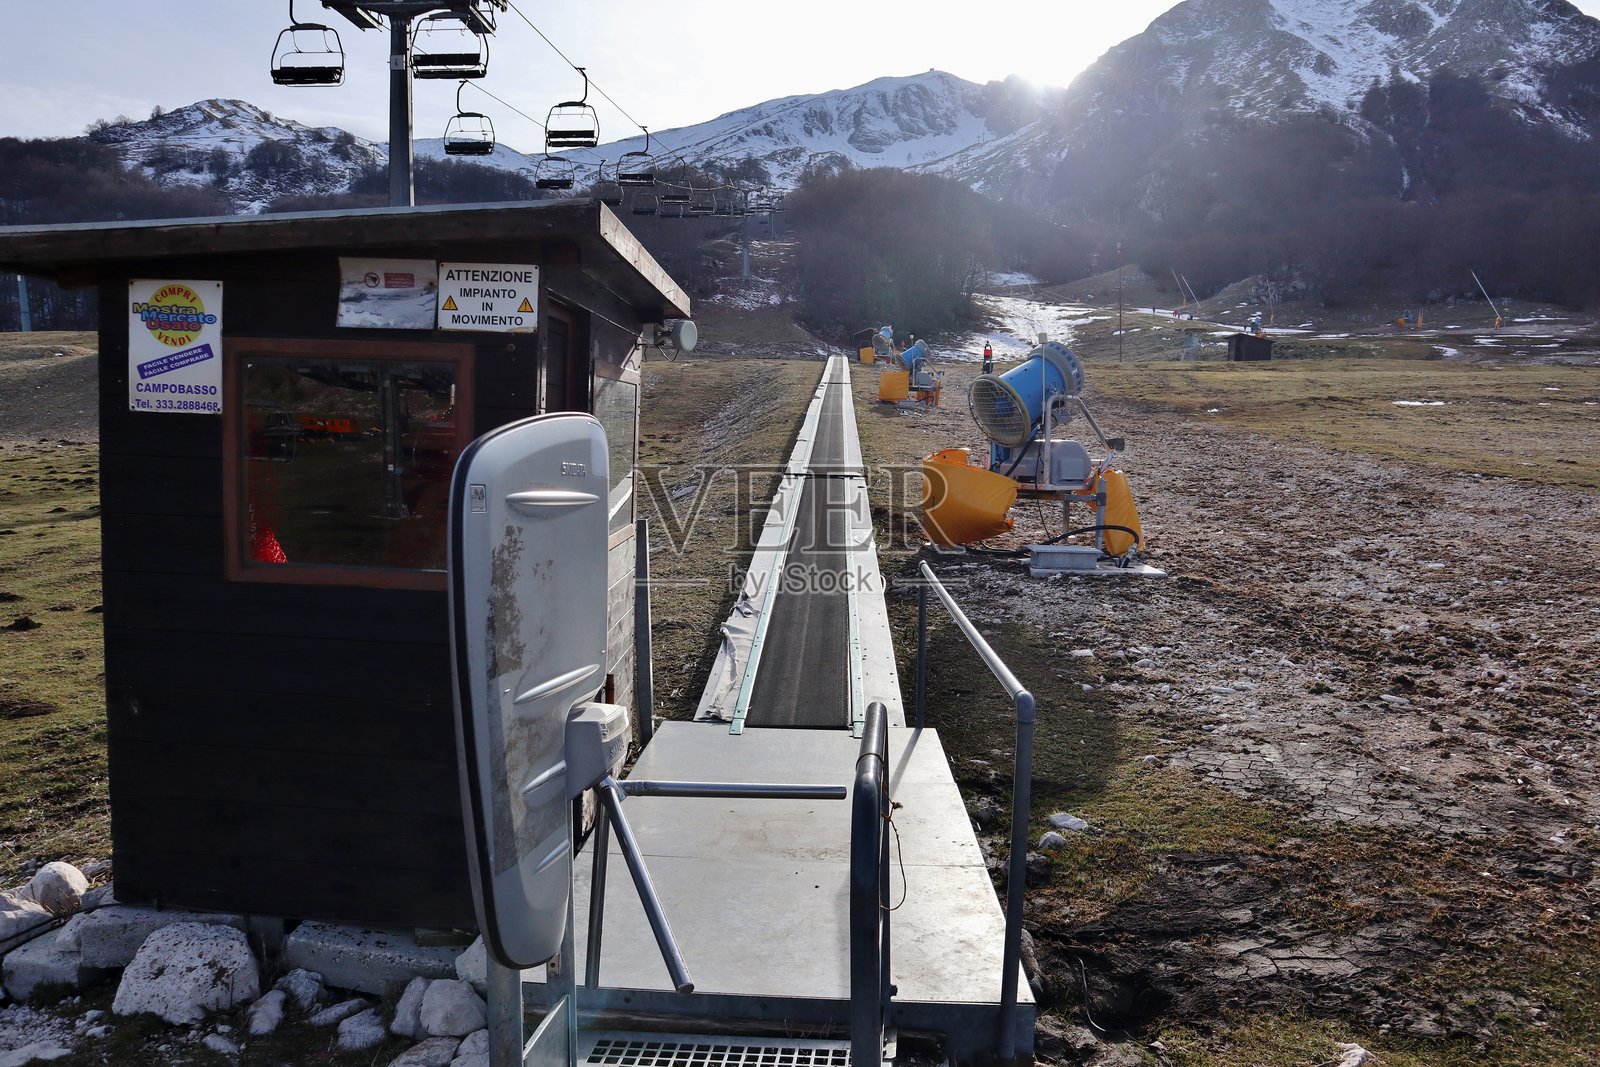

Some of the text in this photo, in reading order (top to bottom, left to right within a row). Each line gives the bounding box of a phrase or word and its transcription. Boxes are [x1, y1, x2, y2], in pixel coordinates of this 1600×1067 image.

[445, 269, 532, 283] ATTENZIONE
[154, 287, 197, 303] COMPRI
[459, 288, 517, 299] IMPIANTO
[132, 302, 198, 315] Mostra
[481, 302, 493, 312] IN
[140, 310, 217, 324] Mercato
[451, 314, 523, 326] MOVIMENTO
[146, 318, 202, 331] Usato
[157, 332, 191, 346] VENDI
[143, 348, 203, 370] FACILE VENDERE
[144, 353, 210, 377] FACILE COMPRARE
[136, 383, 217, 395] CAMPOBASSO
[135, 399, 153, 409] Tel.
